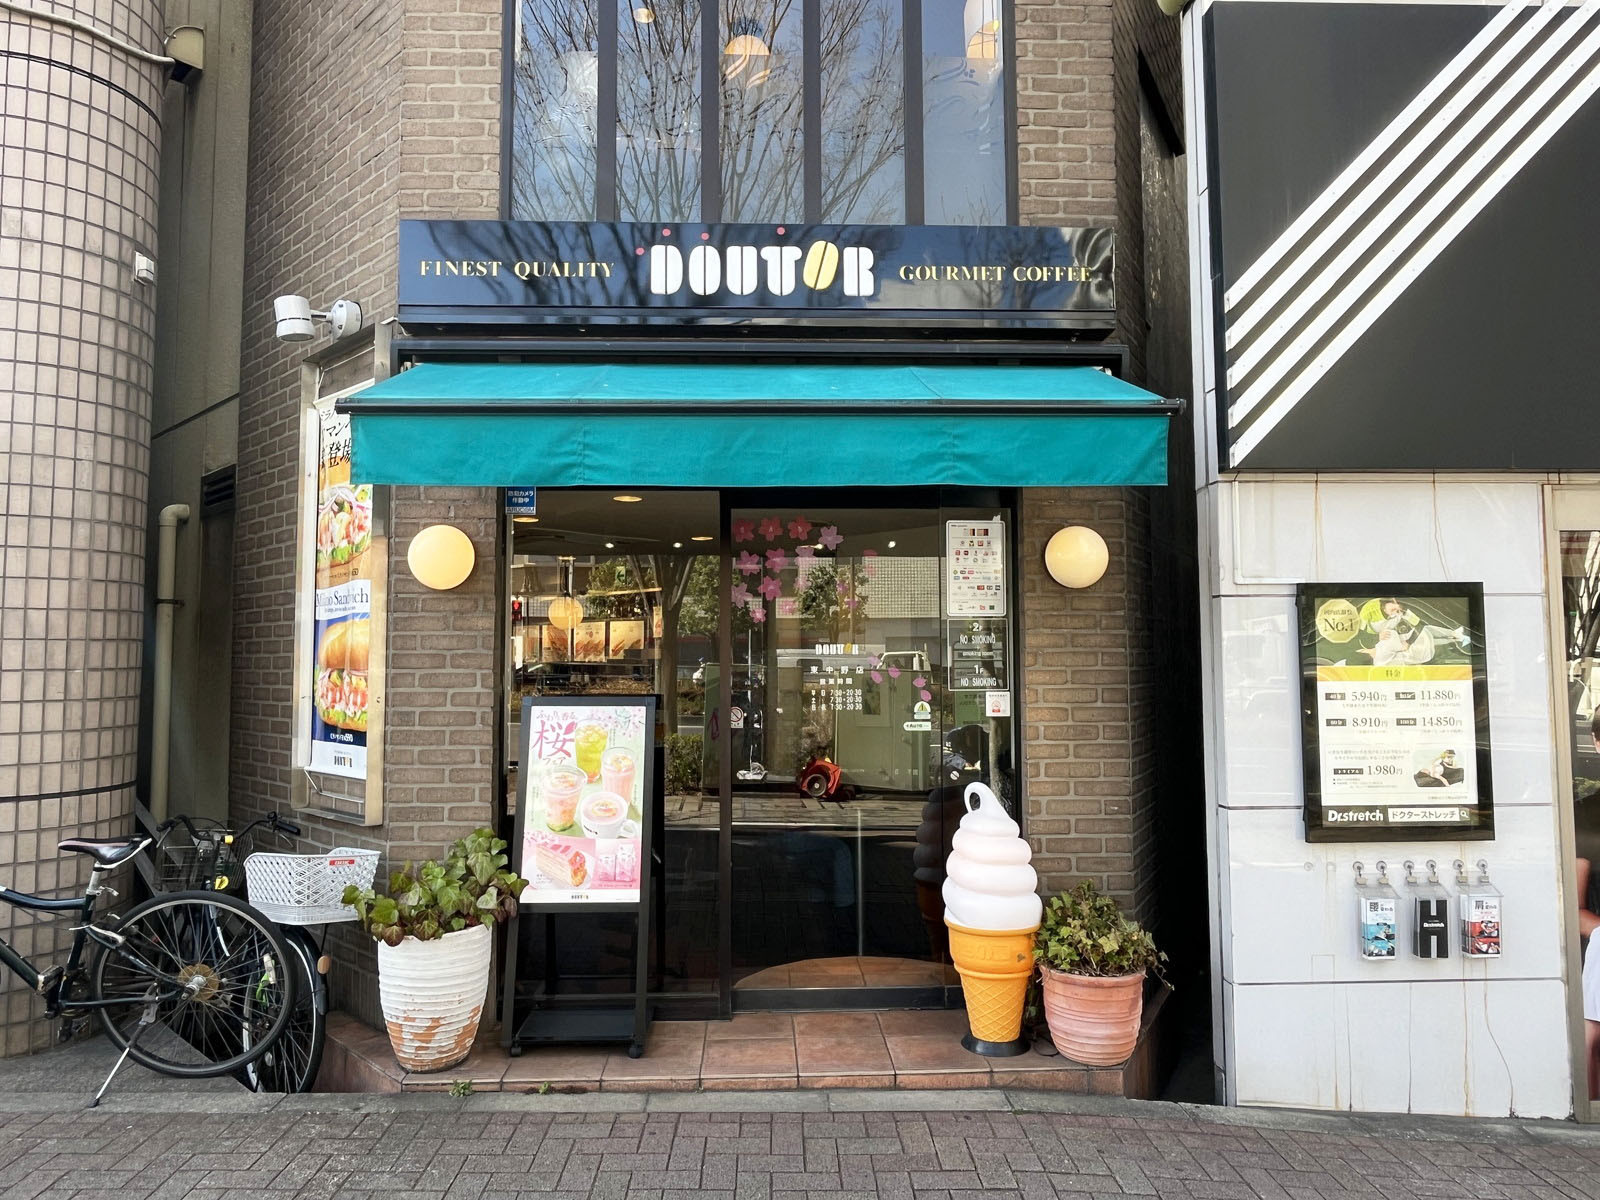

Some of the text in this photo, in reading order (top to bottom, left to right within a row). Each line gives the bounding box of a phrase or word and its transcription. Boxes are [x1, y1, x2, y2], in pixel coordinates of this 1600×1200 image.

[419, 259, 615, 282] FINEST QUALITY
[650, 240, 875, 298] DOUTOR
[899, 263, 1092, 284] GOURMET COFFEE
[1324, 618, 1354, 632] No.1
[959, 633, 996, 645] NO SMOKING
[815, 643, 859, 655] DOUTOR
[960, 677, 997, 687] NO SMOKING
[531, 719, 578, 760] 桜
[1327, 809, 1384, 822] Dr.stretch
[1391, 810, 1457, 820] ドクターストレッチ
